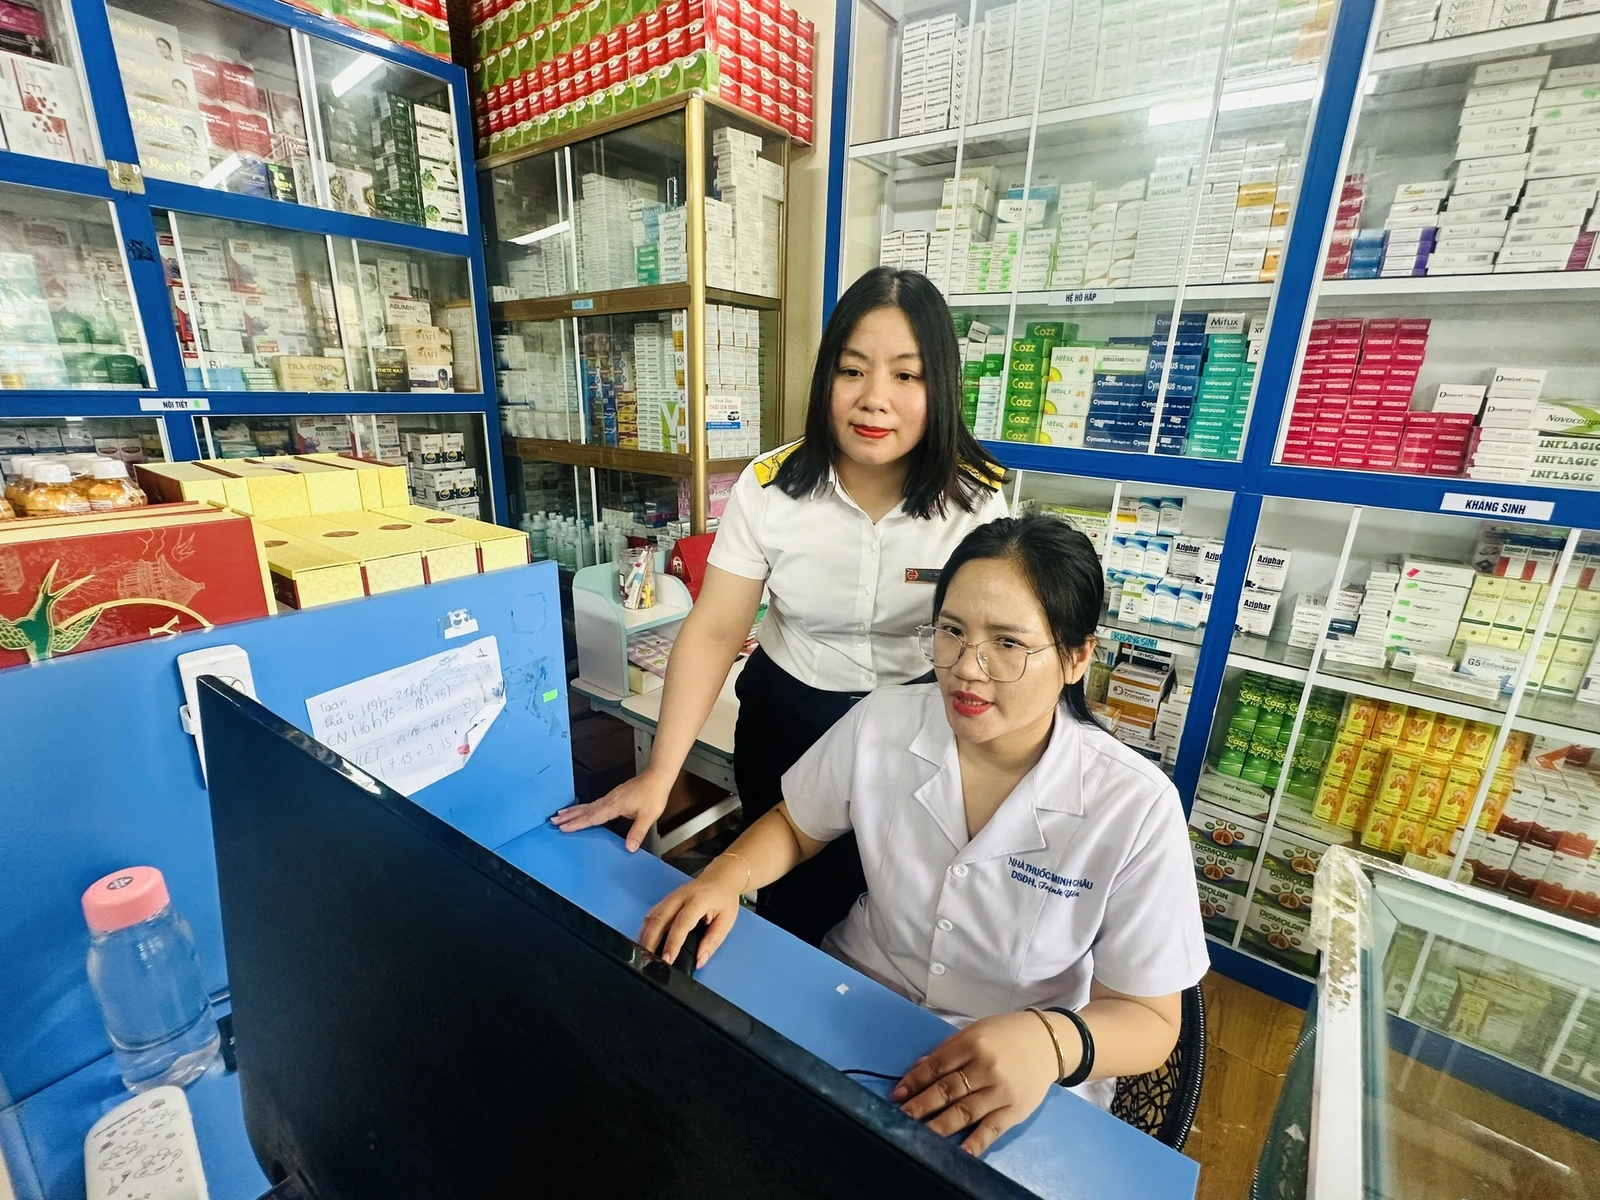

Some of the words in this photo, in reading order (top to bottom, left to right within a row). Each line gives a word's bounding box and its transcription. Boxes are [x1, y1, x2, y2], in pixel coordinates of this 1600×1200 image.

[1210, 317, 1238, 326] Mitux
[1034, 326, 1055, 336] Cozz
[1013, 342, 1036, 352] Cozz
[1012, 360, 1034, 371] Cozz
[1012, 379, 1034, 389] Cozz
[1010, 396, 1032, 407] Cozz
[1008, 413, 1030, 423] Cozz
[1006, 430, 1027, 440] Cozz
[1538, 440, 1600, 451] INFLAGIC
[1534, 455, 1598, 467] INFLAGIC
[1530, 470, 1594, 482] INFLAGIC
[1465, 498, 1499, 512] KHÁNG
[1501, 502, 1526, 515] SINH
[1175, 542, 1200, 554] Aziphar
[1205, 551, 1222, 562] Azip
[1257, 554, 1285, 566] Aziphar
[1243, 599, 1272, 612] Aziphar
[1140, 638, 1158, 648] SINH
[1468, 658, 1481, 667] G5
[1123, 692, 1155, 704] Trimafort
[1240, 690, 1262, 702] Cozz
[1264, 697, 1287, 710] Cozz
[1227, 735, 1248, 748] Cozz
[1251, 742, 1273, 755] Cozz
[1194, 843, 1238, 862] DISMOLAN
[1008, 856, 1025, 870] NHÀ
[1025, 863, 1051, 880] THUỐC
[1051, 874, 1072, 887] MINH
[1072, 878, 1094, 890] CHÂU
[1196, 882, 1229, 900] SMOLAN
[1259, 909, 1305, 933] DISMOLAN
